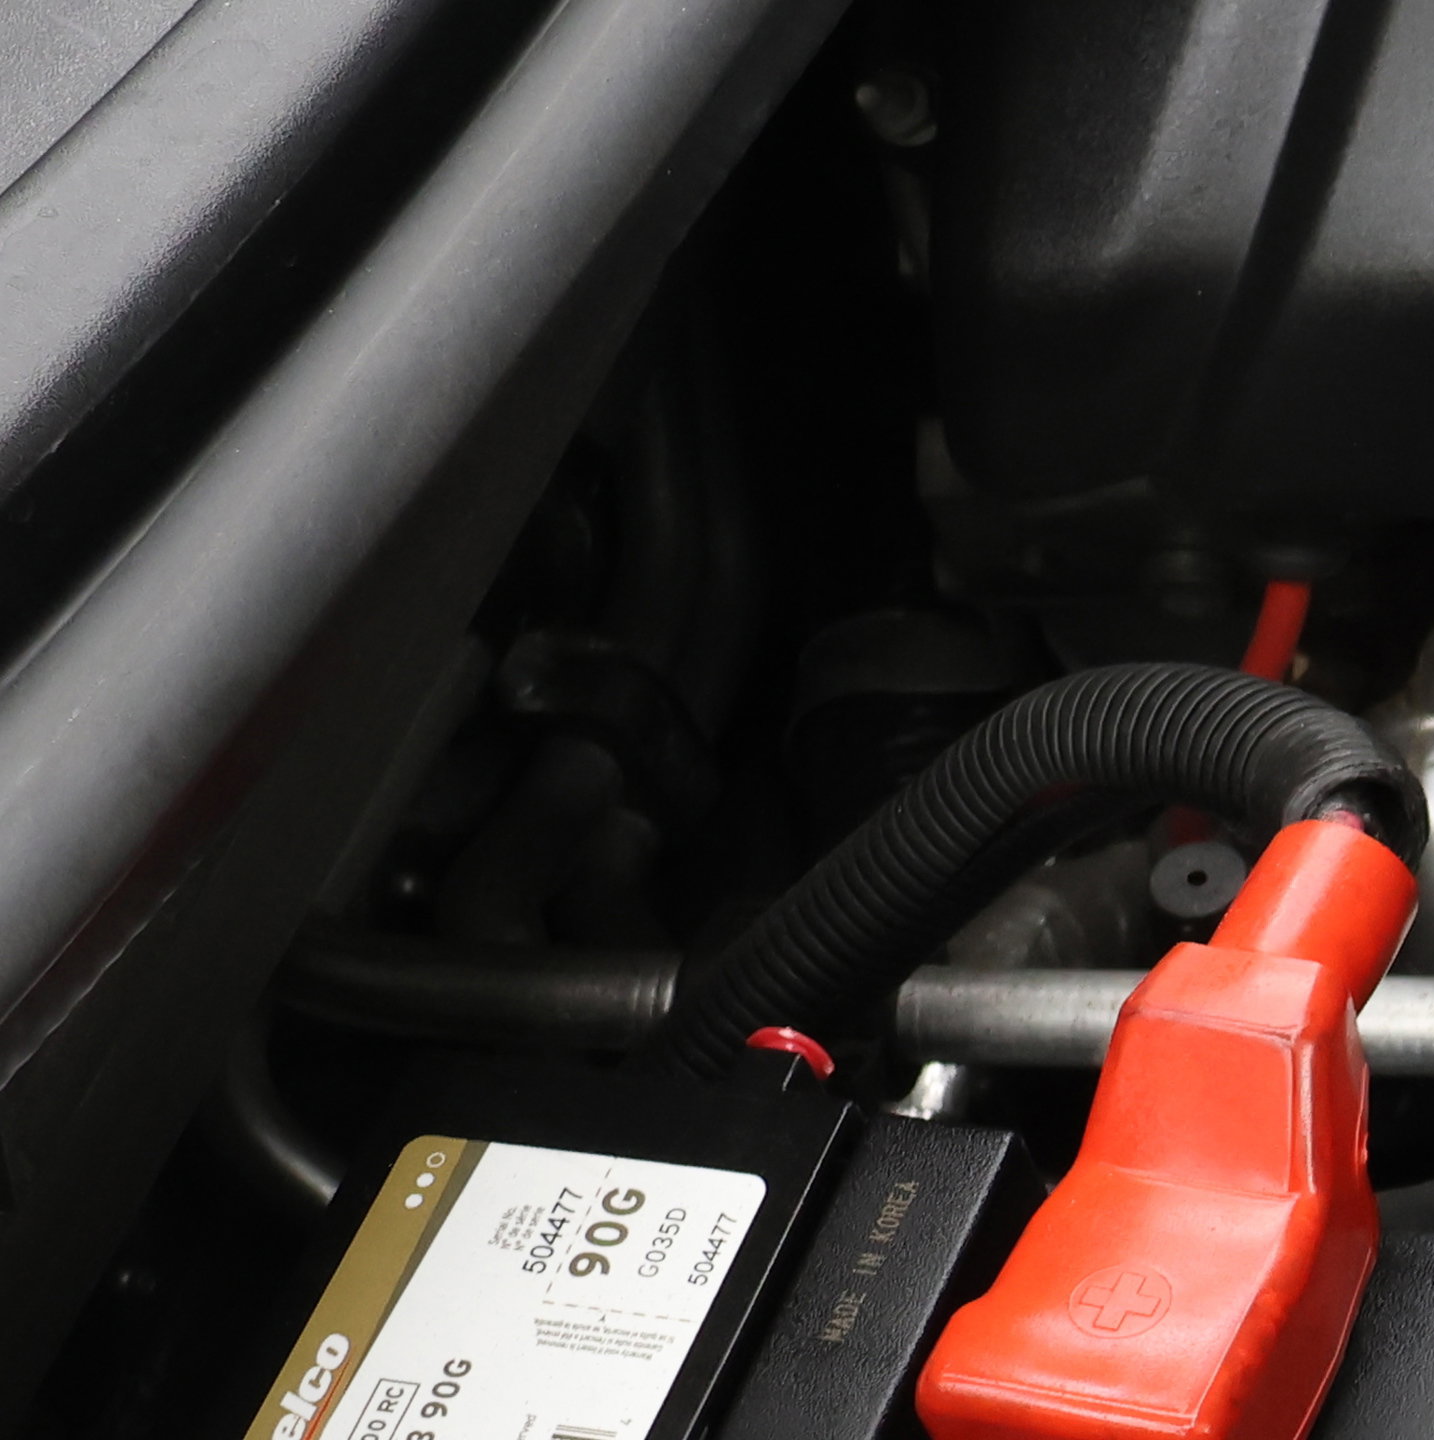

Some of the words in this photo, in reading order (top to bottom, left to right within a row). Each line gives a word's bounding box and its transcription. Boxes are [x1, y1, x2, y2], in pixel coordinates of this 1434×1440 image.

[520, 1186, 583, 1275] 504477
[567, 1186, 647, 1279] 90G
[636, 1206, 688, 1279] G035D
[868, 1180, 920, 1247] KOREA
[686, 1211, 736, 1287] 504477
[852, 1251, 887, 1276] IN
[819, 1288, 867, 1342] MADE
[375, 1385, 406, 1415] RC
[419, 1358, 473, 1420] 90G
